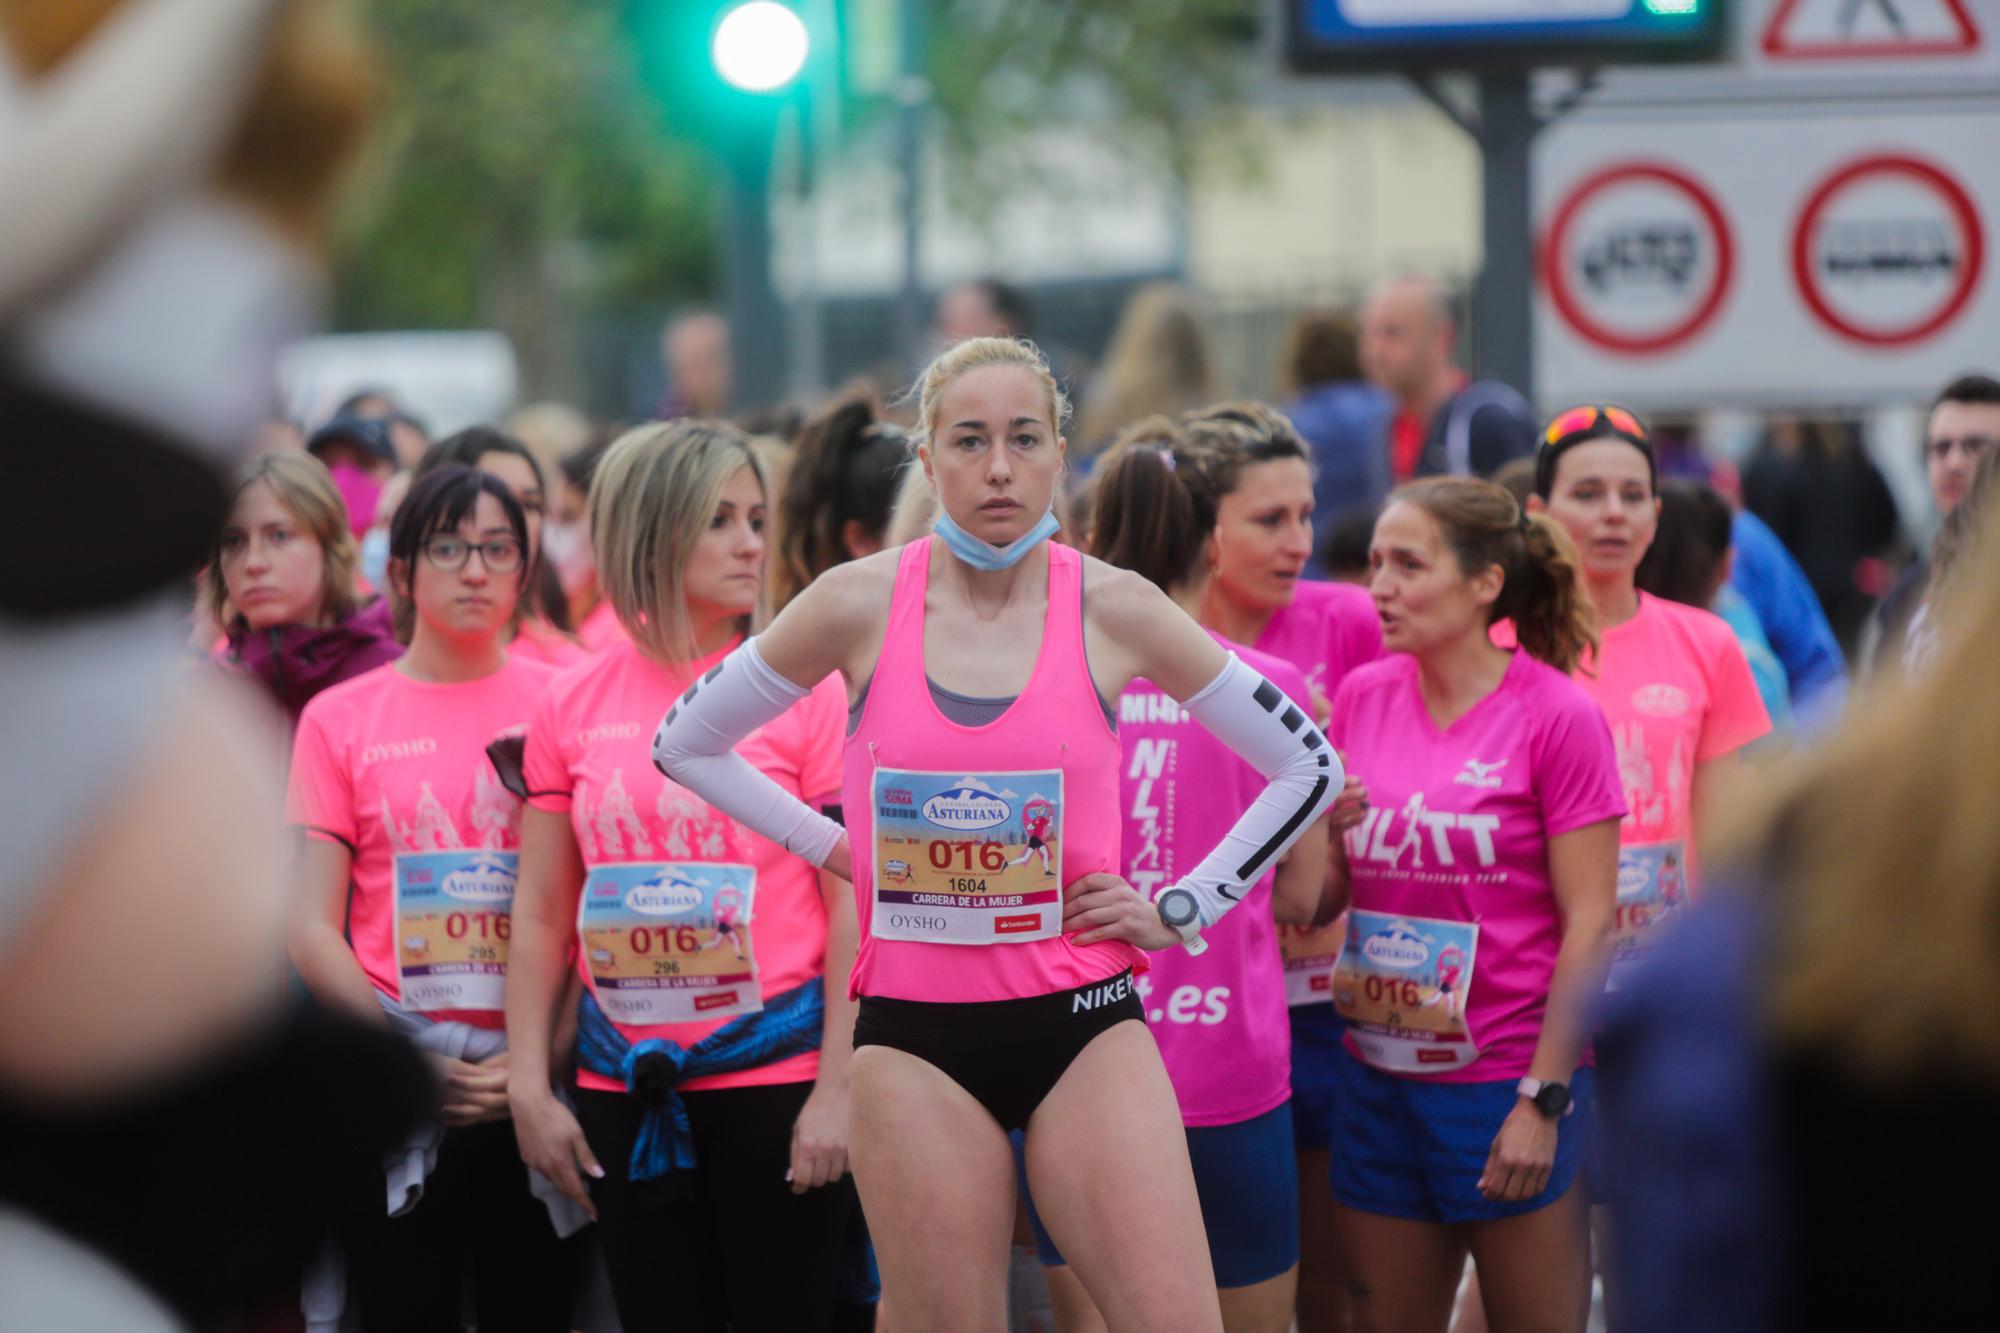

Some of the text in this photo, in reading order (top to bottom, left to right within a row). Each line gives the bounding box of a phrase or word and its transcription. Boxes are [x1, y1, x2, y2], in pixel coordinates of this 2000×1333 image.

[361, 737, 437, 764] OYSHO
[927, 802, 1005, 821] ASTURIANA
[928, 838, 1006, 872] 016
[948, 877, 988, 894] 1604
[912, 893, 1024, 907] CARRERA DE LA MUJER
[446, 911, 512, 941] 016
[890, 914, 947, 931] OYSHO
[630, 926, 700, 954] 016
[468, 945, 497, 960] 295
[653, 960, 681, 975] 296
[1364, 973, 1419, 1007] 016
